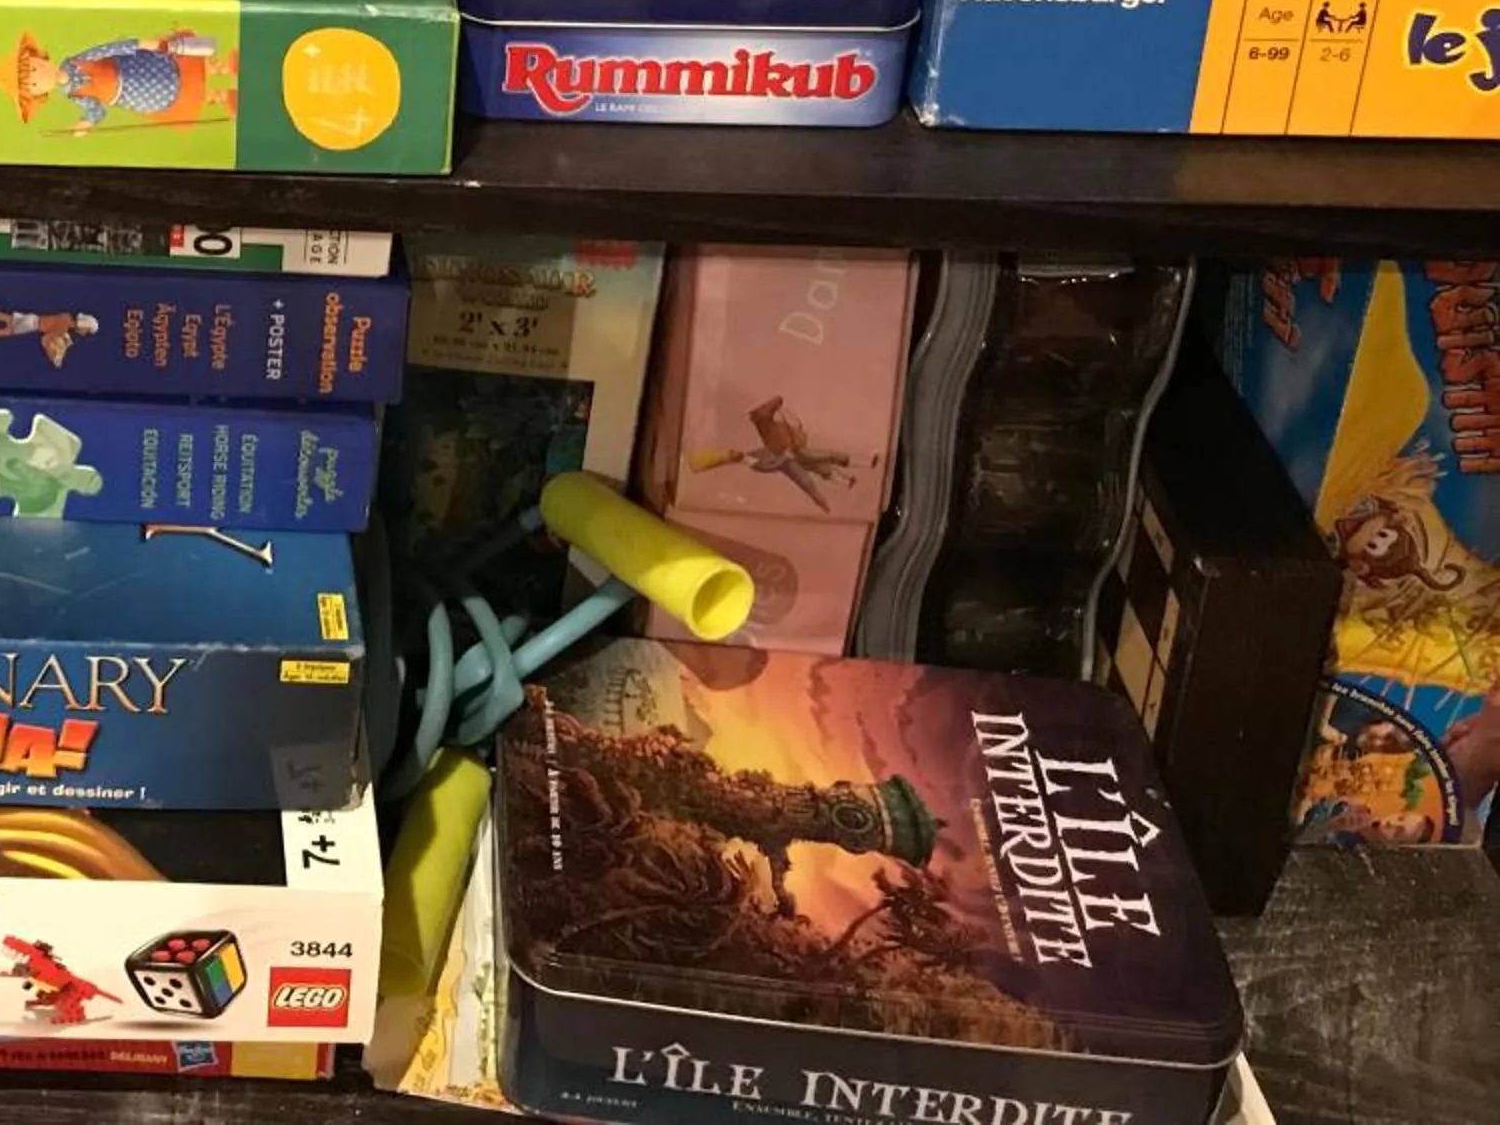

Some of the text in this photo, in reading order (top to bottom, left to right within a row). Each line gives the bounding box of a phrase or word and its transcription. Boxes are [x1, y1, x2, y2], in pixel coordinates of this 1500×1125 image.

[1257, 7, 1294, 25] Age
[1407, 13, 1467, 66] le
[503, 42, 878, 115] Rummikub
[1248, 47, 1290, 62] 6-99
[1319, 48, 1350, 62] 2-6
[125, 309, 142, 358] Egipto
[153, 303, 175, 367] Ägypten
[182, 313, 200, 358] Egypt
[211, 304, 231, 369] L'Égypte
[266, 313, 284, 380] POSTER
[319, 292, 340, 394] observation
[349, 316, 371, 372] Puzzle
[175, 434, 192, 507] REITSPORT
[213, 425, 229, 470] HORSE
[26, 784, 47, 795] et
[52, 784, 135, 799] dessiner
[303, 834, 341, 868] 7+
[971, 710, 1093, 968] INTERDITE
[1035, 749, 1161, 938] L'ÎLE
[290, 941, 353, 958] 3844
[273, 984, 347, 1011] LEGO
[612, 1043, 765, 1099] L'ÎLE
